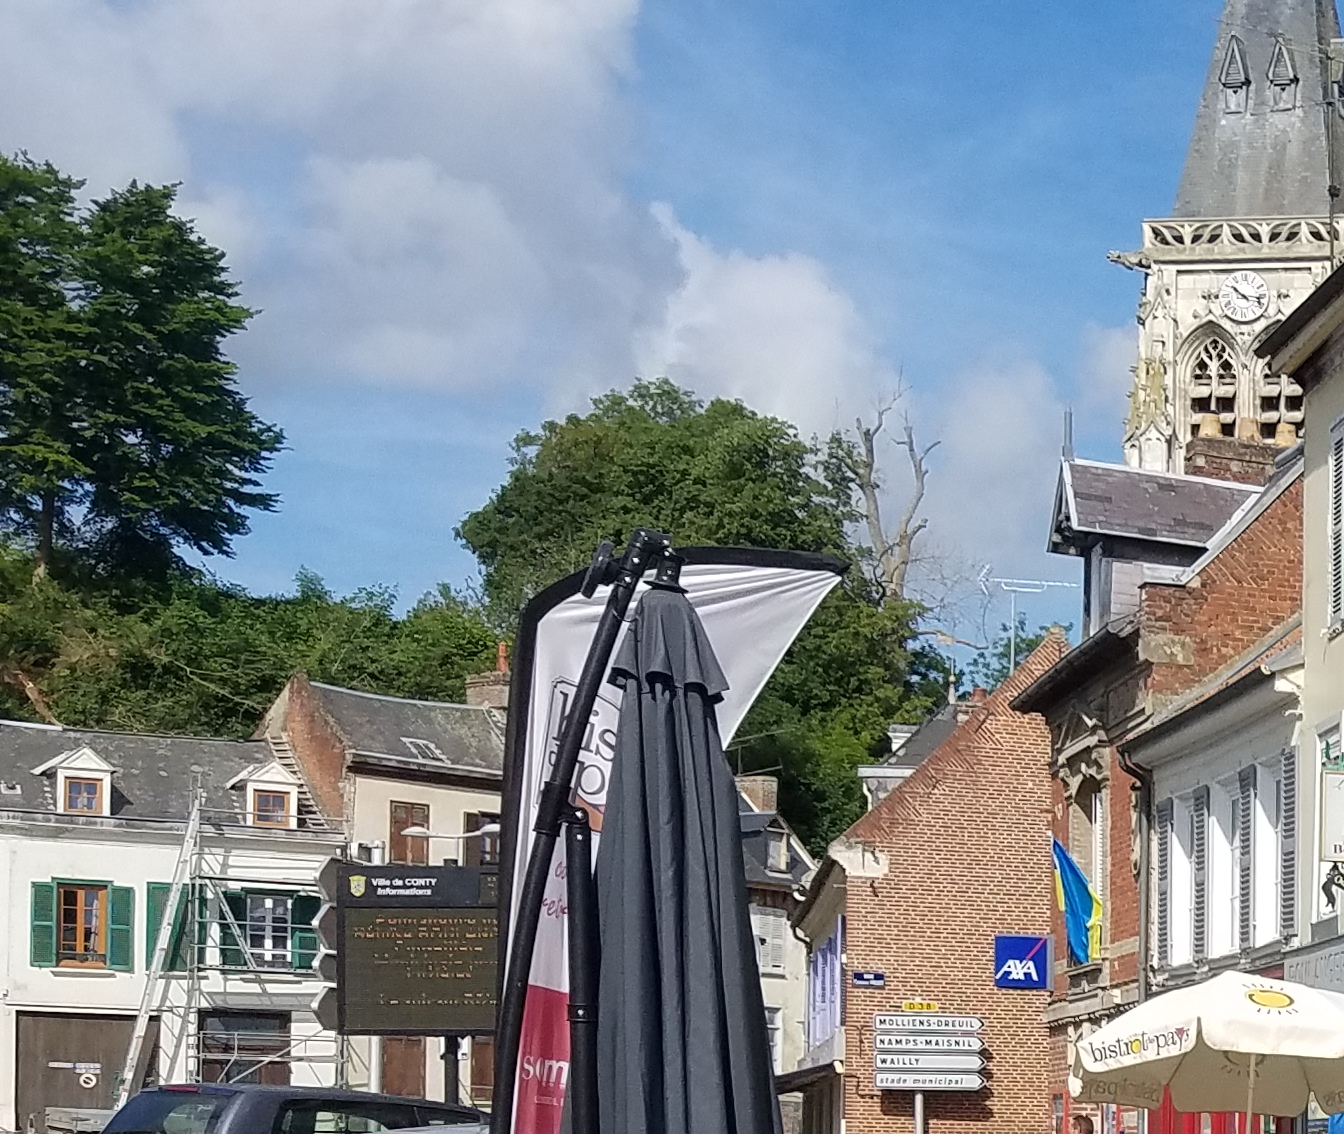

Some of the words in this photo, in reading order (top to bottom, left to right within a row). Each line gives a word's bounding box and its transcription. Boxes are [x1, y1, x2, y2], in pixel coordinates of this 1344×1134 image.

[405, 878, 438, 887] CONTY
[995, 959, 1039, 982] AXA
[879, 1018, 975, 1028] MOLLIENS-DREUIL
[879, 1038, 973, 1048] NAMPS-MAISNIL
[1089, 1030, 1150, 1063] bistrot
[879, 1057, 921, 1066] WAILLY
[879, 1077, 907, 1085] stade
[912, 1077, 964, 1087] municipal
